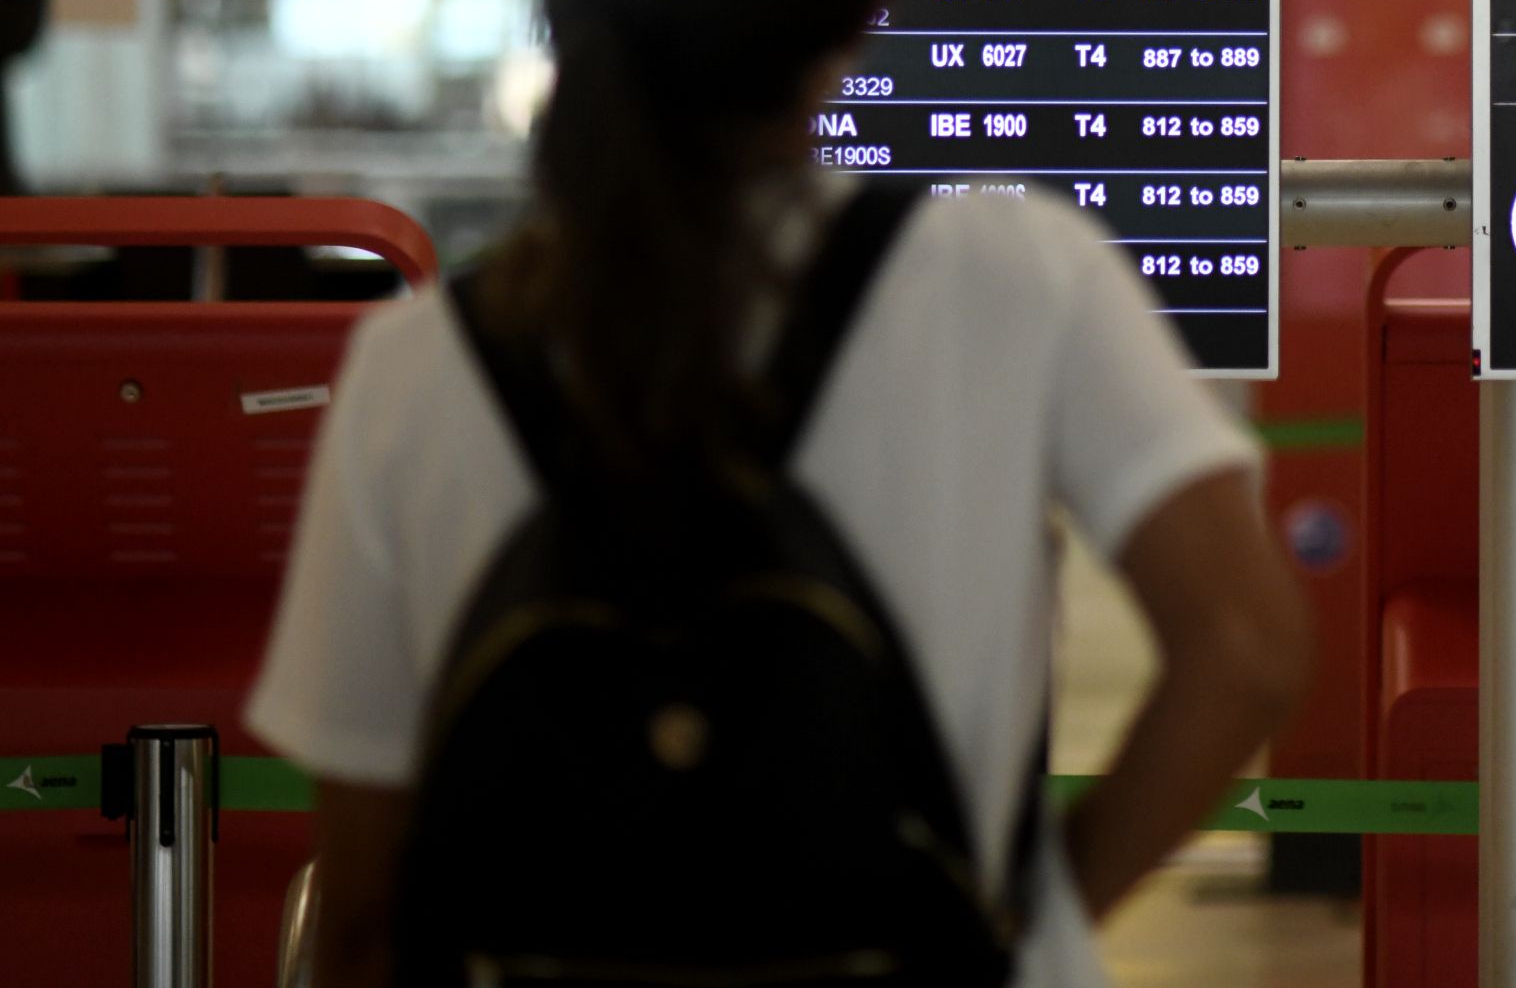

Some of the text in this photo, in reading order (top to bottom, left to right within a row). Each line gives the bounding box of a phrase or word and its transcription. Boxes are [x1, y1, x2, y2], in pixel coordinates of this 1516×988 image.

[932, 44, 1259, 68] UX 6027 T4 887 to 889
[842, 77, 893, 96] 3329
[1142, 256, 1259, 277] 812 to 859
[1268, 799, 1304, 810] aena
